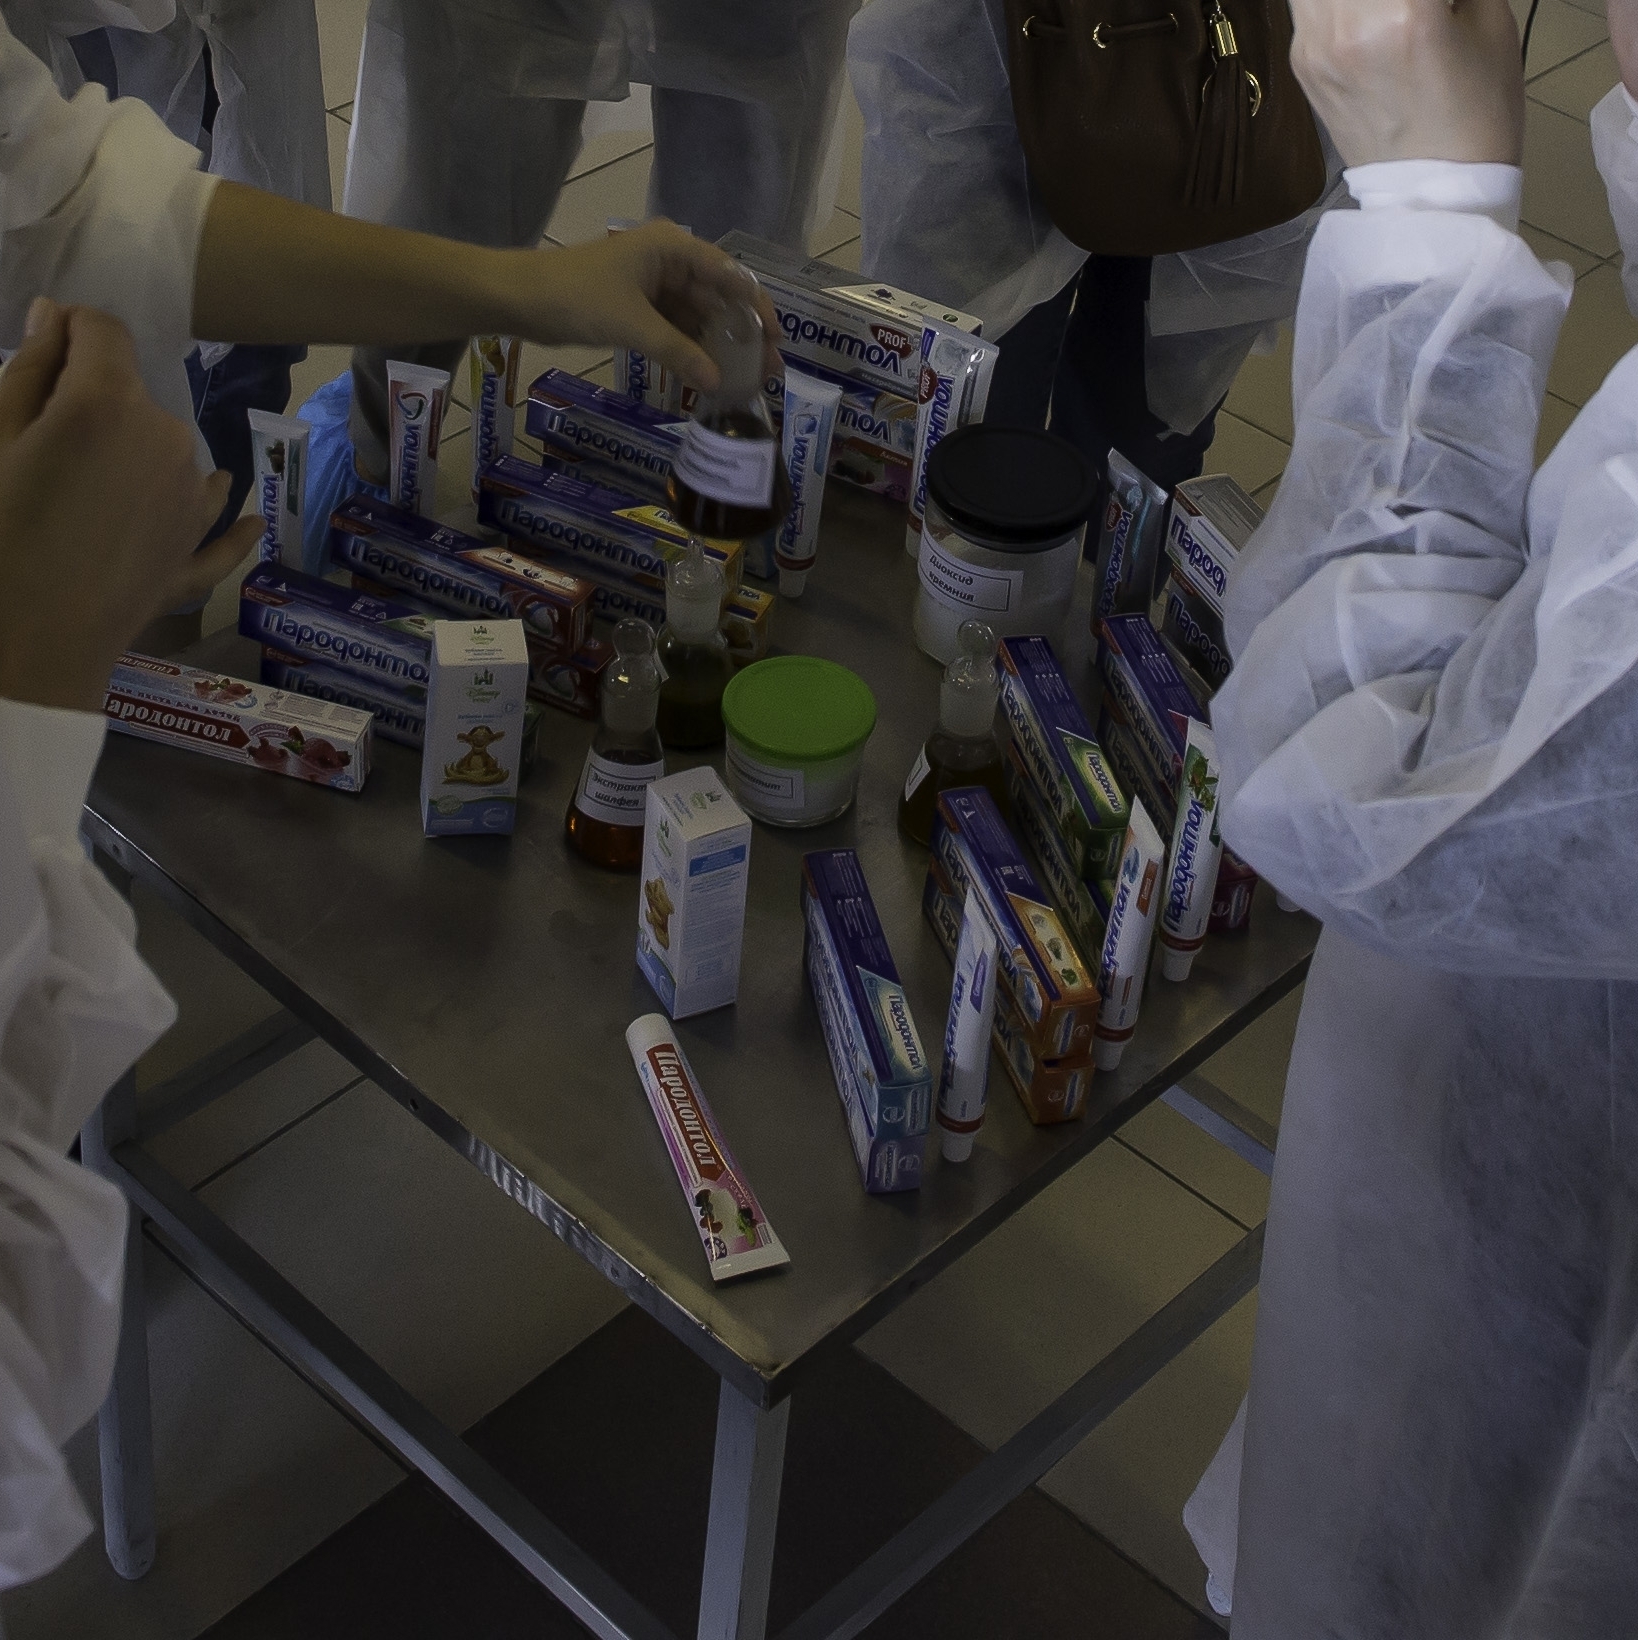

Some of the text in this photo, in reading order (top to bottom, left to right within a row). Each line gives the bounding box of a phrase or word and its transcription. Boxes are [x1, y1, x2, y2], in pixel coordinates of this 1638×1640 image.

[877, 328, 907, 349] PROF
[919, 372, 931, 399] PROF
[501, 500, 665, 577] Пародонтол
[1097, 511, 1132, 614] ародонтол
[351, 536, 512, 618] Пародонтол
[929, 554, 973, 586] Диоксид
[929, 570, 974, 601] кремния
[262, 606, 429, 684] Пародонто
[592, 772, 647, 791] Экстракт
[594, 791, 640, 807] шалфея
[1163, 798, 1204, 930] Пародонтол
[654, 1050, 717, 1166] Пародонтол
